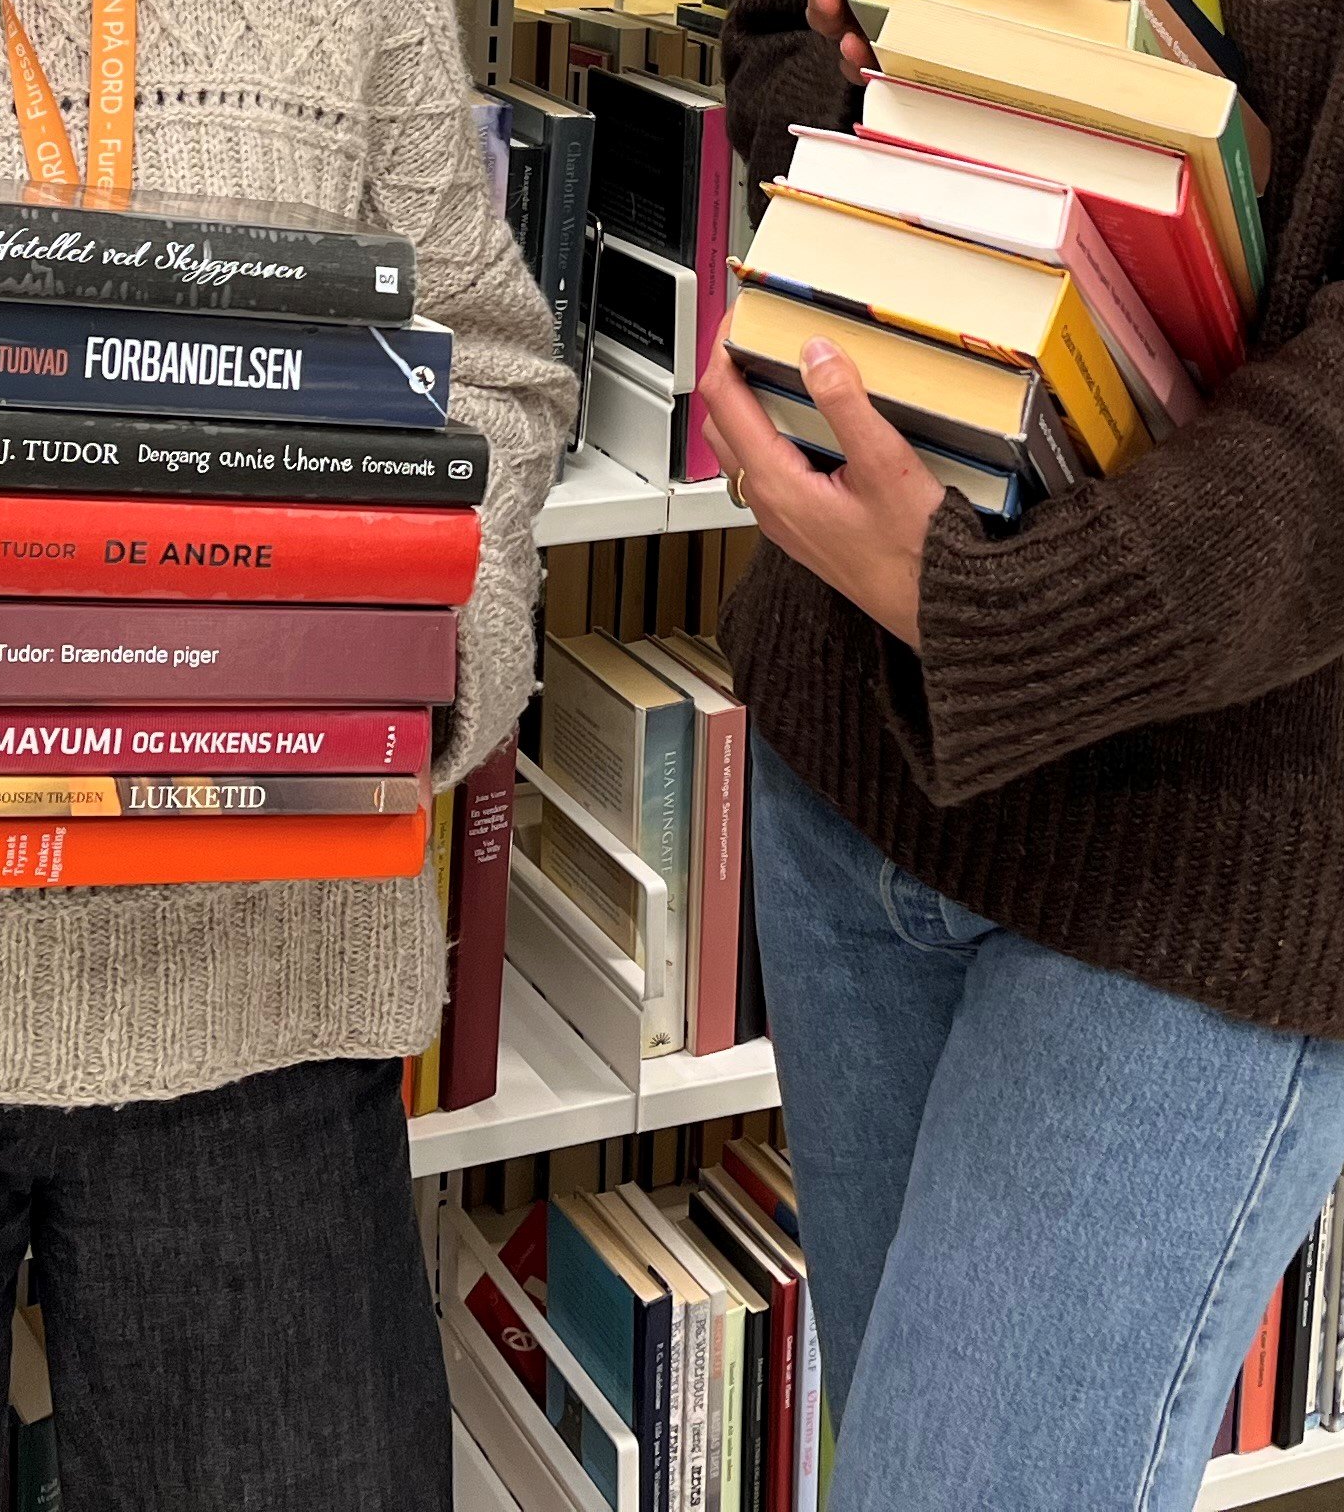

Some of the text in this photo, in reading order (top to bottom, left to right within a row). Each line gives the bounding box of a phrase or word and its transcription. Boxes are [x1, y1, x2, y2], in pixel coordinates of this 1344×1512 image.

[102, 22, 128, 53] PÅ
[16, 42, 47, 121] Furesø
[100, 58, 123, 115] ORD
[101, 242, 148, 267] ved
[154, 241, 307, 286] Skyggesøen
[84, 337, 302, 390] FORBANDELSEN
[23, 440, 118, 466] TUDOR
[137, 444, 210, 473] Dengang
[218, 449, 275, 470] annie
[283, 446, 353, 473] thorne
[361, 455, 435, 478] forsvandt
[0, 541, 76, 559] TUDOR
[104, 540, 149, 565] DE
[159, 542, 272, 568] ANDRE
[60, 645, 169, 665] Brændende
[173, 645, 219, 667] piger
[132, 732, 166, 755] OG
[169, 731, 271, 755] LYKKENS
[276, 732, 324, 755] HAV
[663, 750, 677, 789] LISA
[129, 785, 266, 810] LUKKETID
